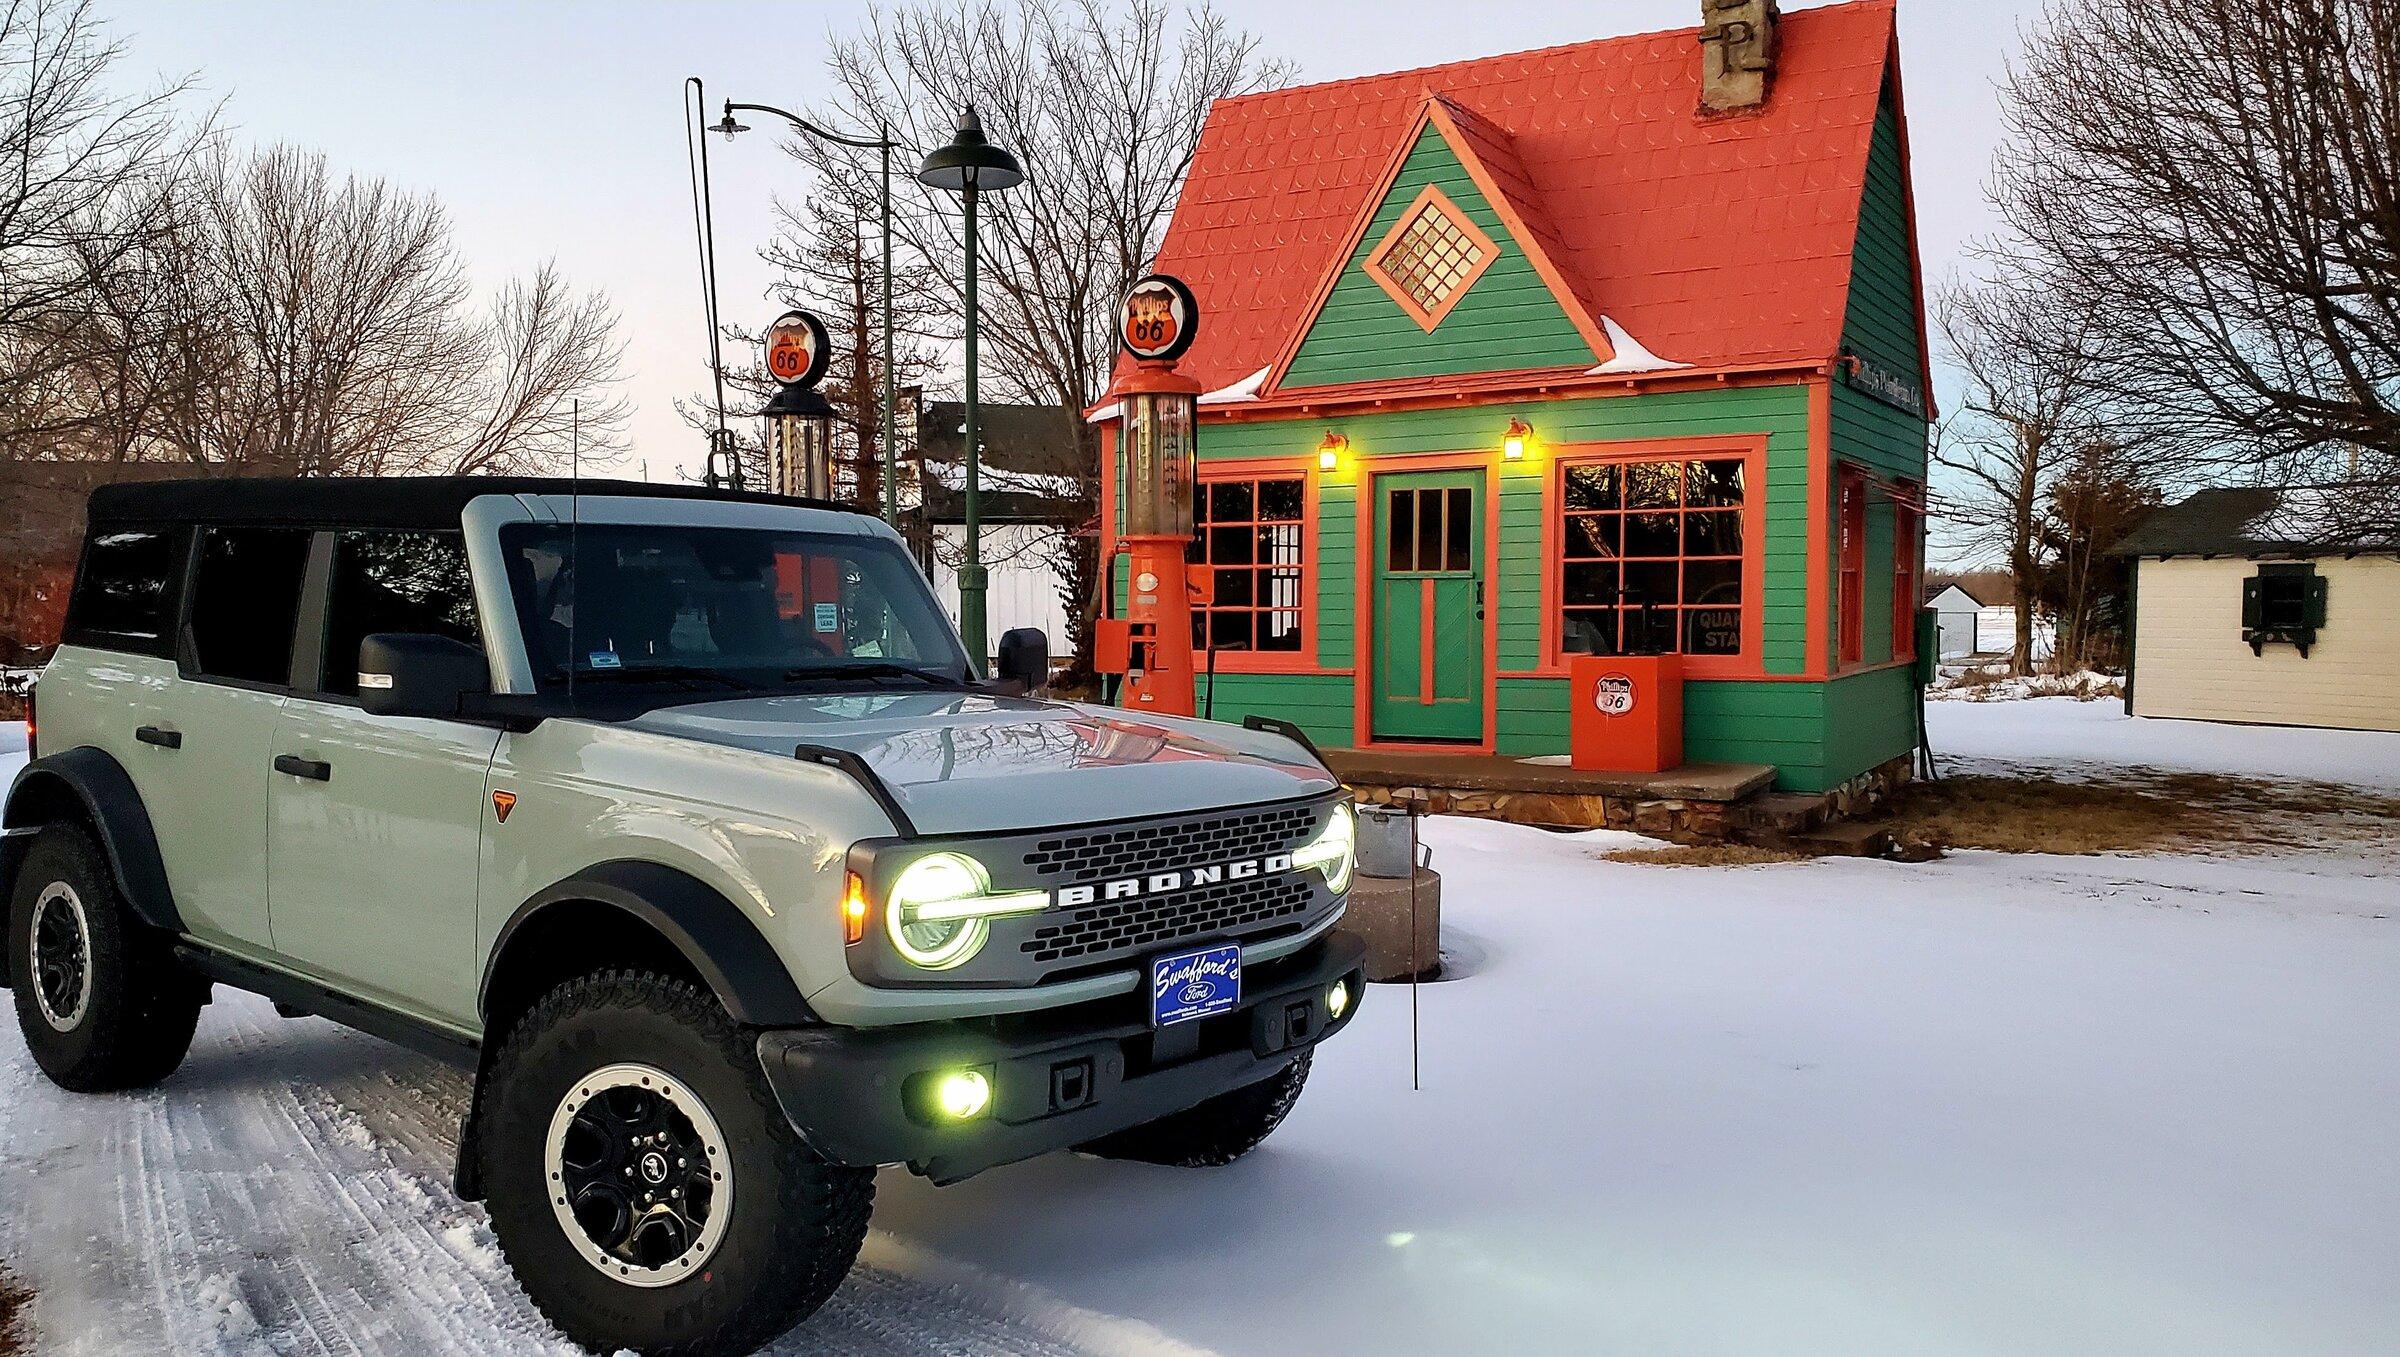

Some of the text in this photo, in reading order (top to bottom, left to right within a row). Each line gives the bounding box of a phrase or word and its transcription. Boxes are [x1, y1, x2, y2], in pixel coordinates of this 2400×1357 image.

[1135, 319, 1165, 341] 66
[776, 349, 800, 371] 66
[1057, 854, 1292, 907] BRONCO
[1156, 955, 1239, 999] Swafford's
[1184, 984, 1209, 1001] Ford
